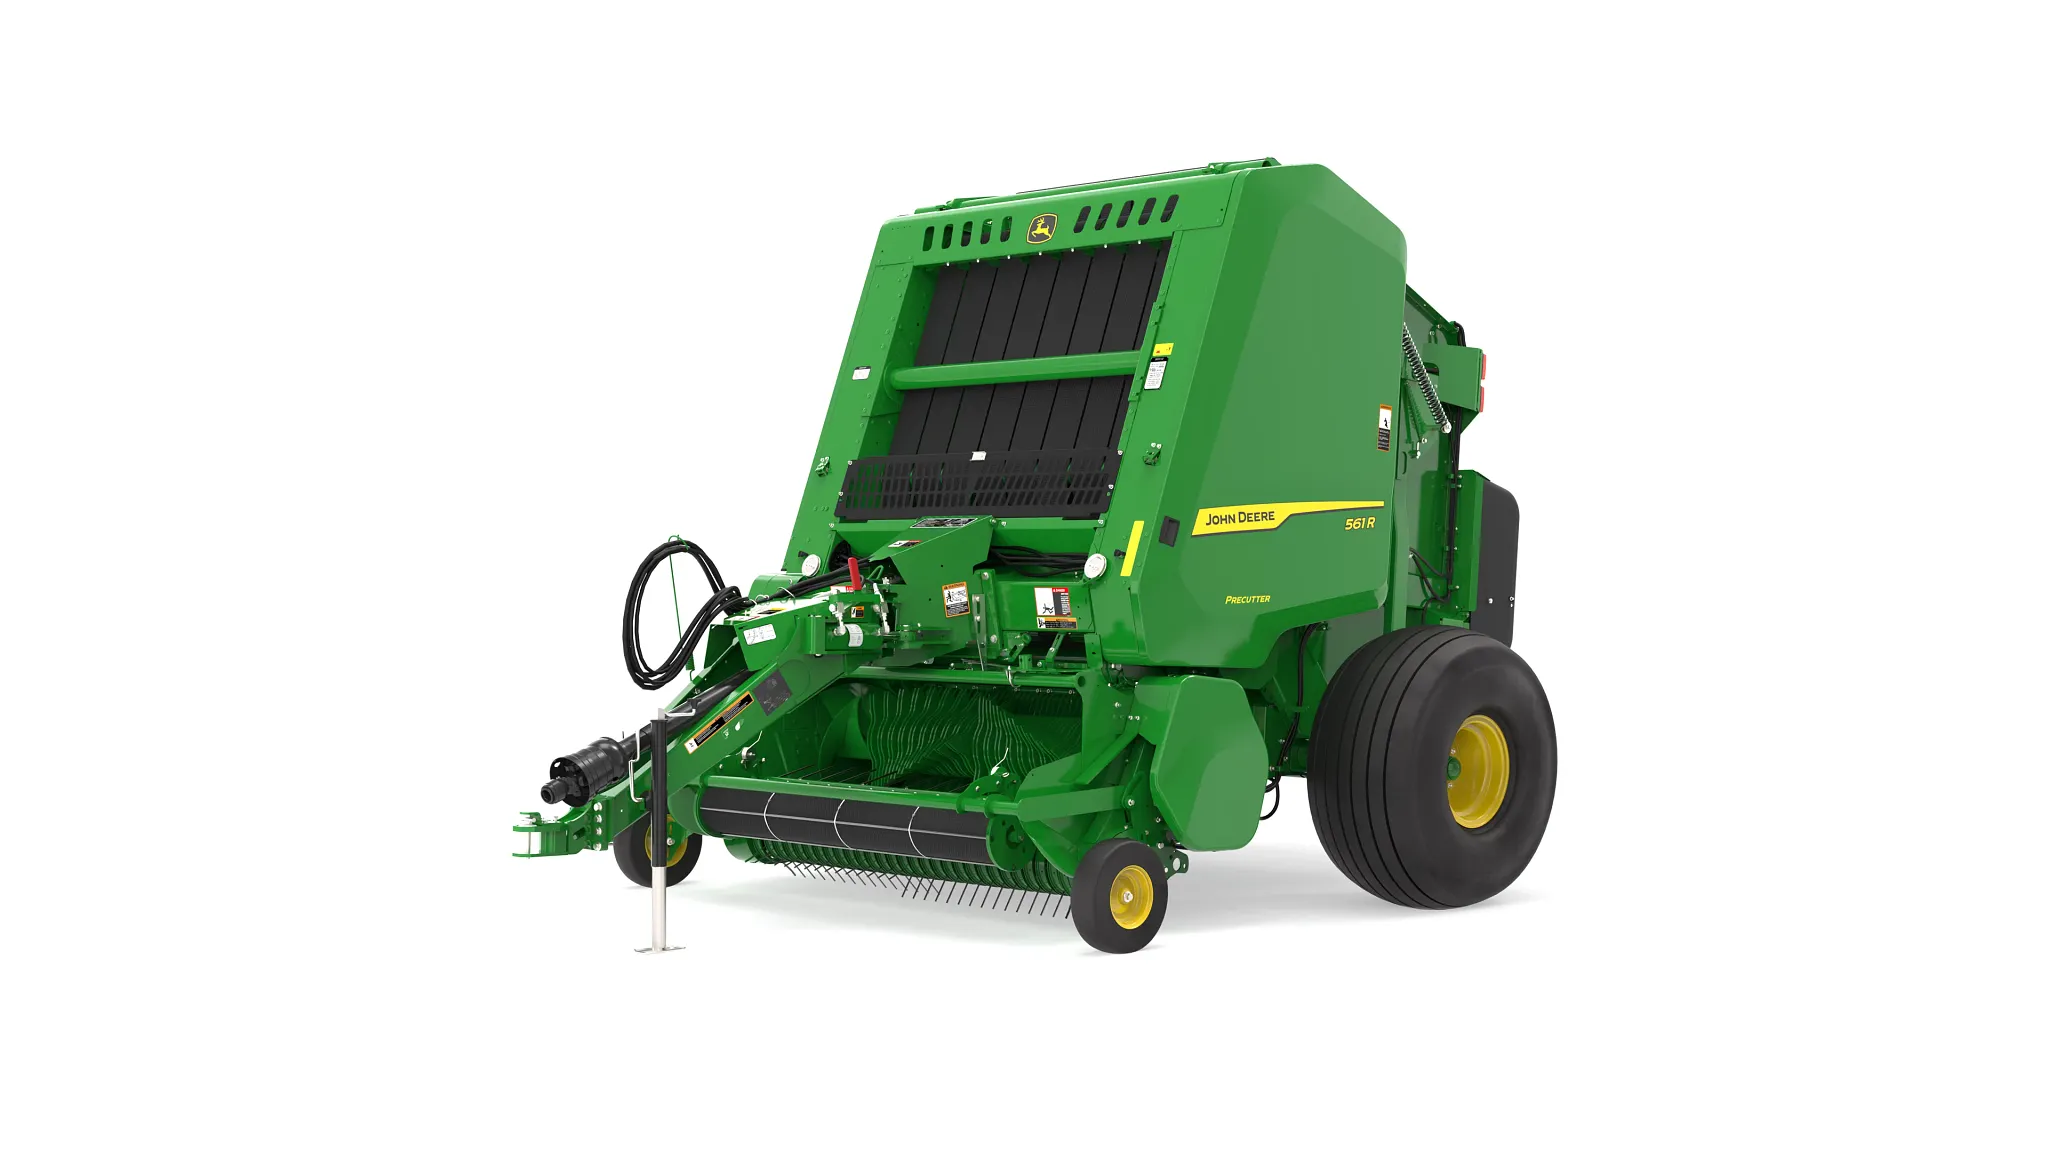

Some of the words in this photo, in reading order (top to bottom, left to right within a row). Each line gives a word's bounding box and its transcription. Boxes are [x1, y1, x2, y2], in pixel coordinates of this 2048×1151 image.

[1206, 513, 1236, 526] JOHN
[1238, 511, 1275, 523] DEERE
[1225, 594, 1271, 605] PRECUTTER
